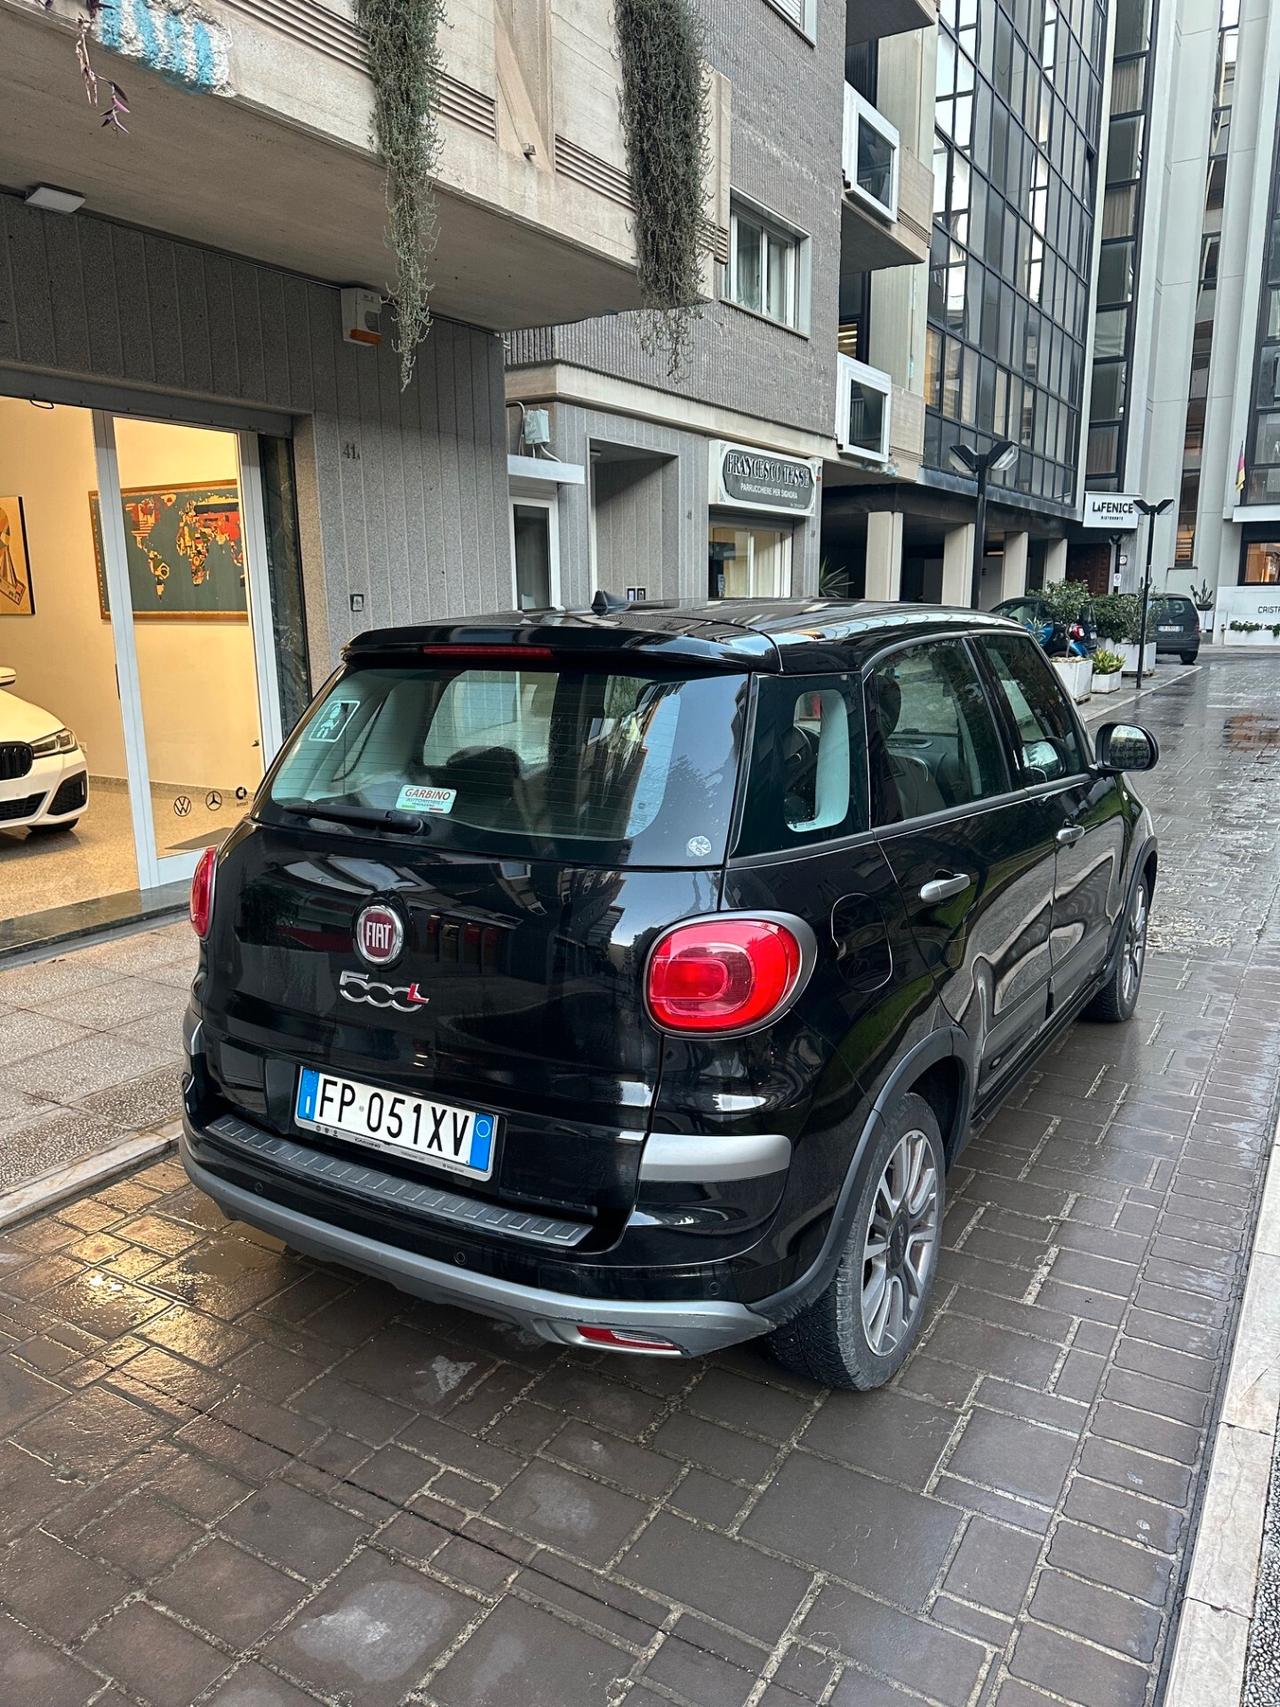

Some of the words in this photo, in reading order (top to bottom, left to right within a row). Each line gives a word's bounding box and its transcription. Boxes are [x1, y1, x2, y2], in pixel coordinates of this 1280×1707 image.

[727, 452, 781, 483] FRANCESCO
[740, 482, 772, 496] PARRUCCHIERE
[772, 487, 780, 497] PER
[781, 489, 798, 499] SIGNORA
[405, 788, 451, 801] GARBINO
[366, 921, 392, 949] FIAT
[318, 1078, 356, 1123] FP
[366, 1092, 470, 1157] 051XV
